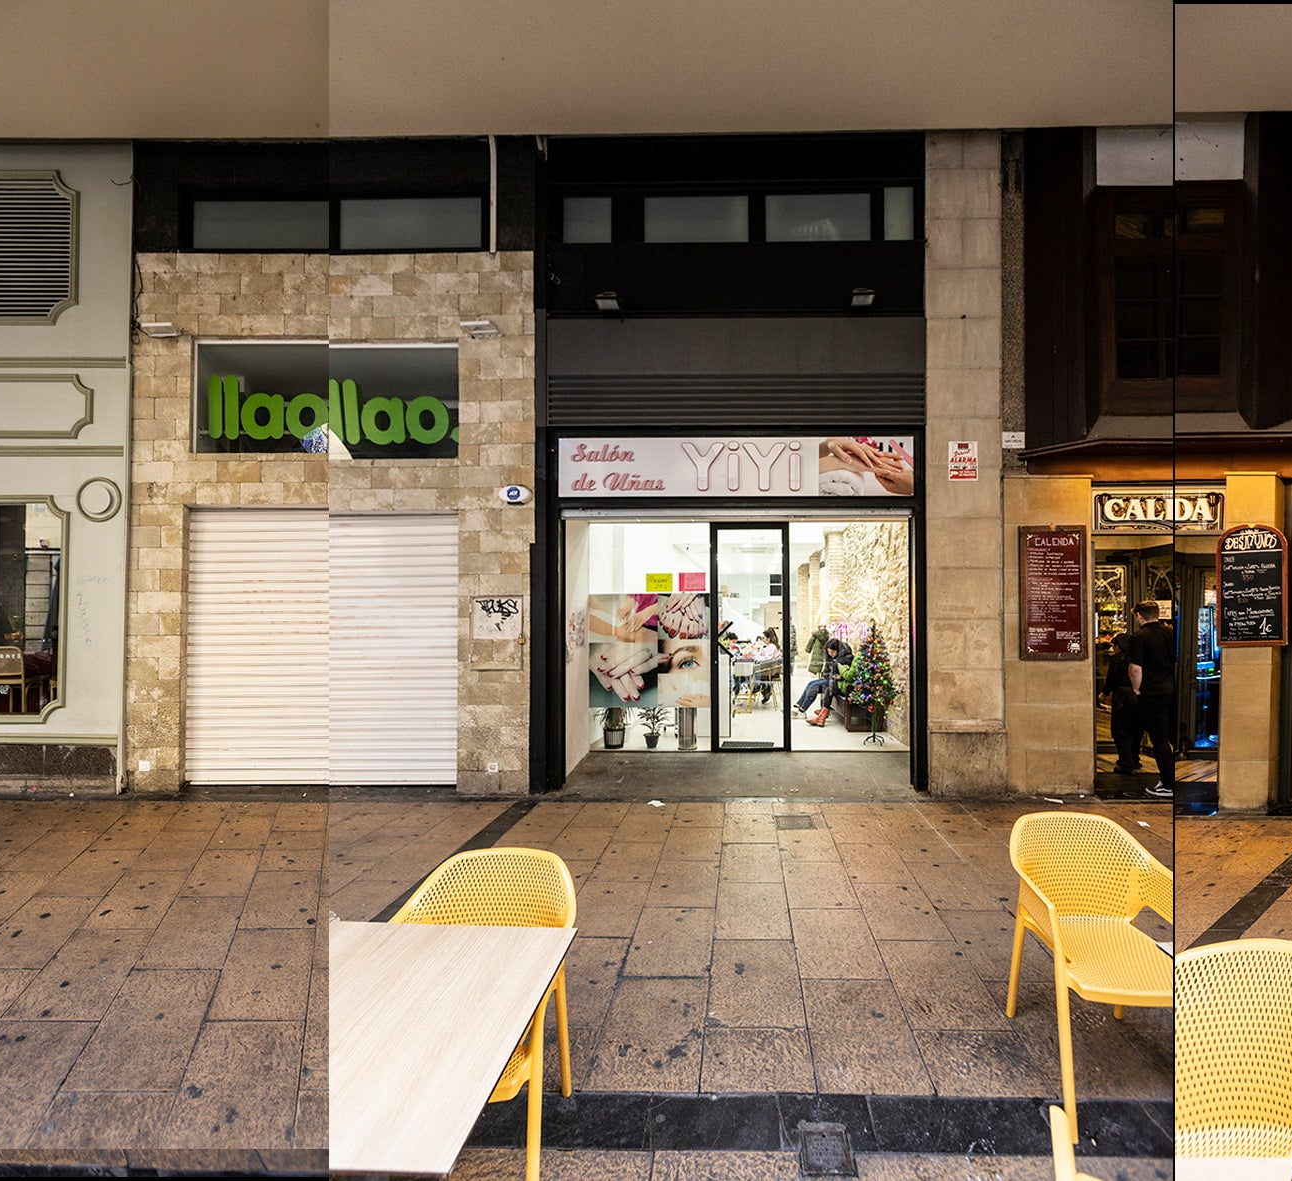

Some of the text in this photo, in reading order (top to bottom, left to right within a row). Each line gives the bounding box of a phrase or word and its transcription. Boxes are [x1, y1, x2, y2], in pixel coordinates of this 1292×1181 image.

[570, 443, 636, 463] Salón
[570, 472, 666, 491] de Uñas
[1034, 537, 1075, 546] CALENDA
